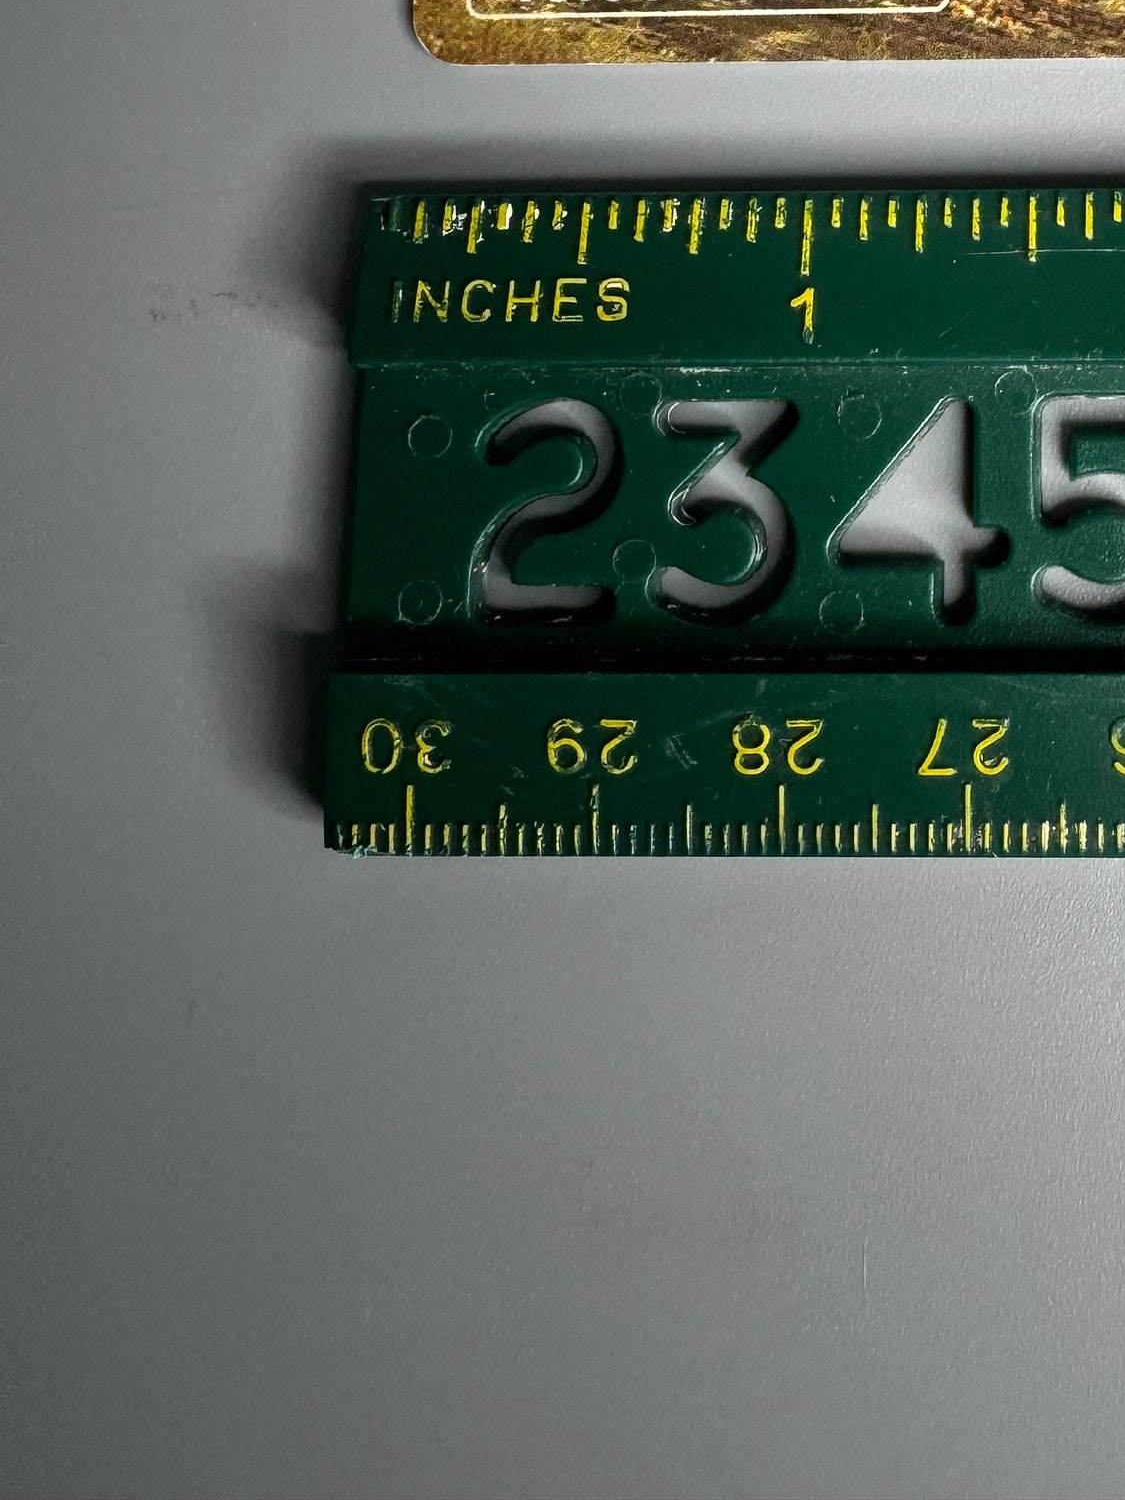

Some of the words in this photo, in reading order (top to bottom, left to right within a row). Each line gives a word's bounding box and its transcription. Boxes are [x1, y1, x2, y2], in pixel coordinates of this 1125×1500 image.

[390, 277, 631, 323] INCHES
[790, 287, 815, 344] 1
[361, 716, 453, 775] 30
[546, 717, 638, 775] 29
[731, 714, 824, 776] 28
[918, 717, 1009, 777] 27
